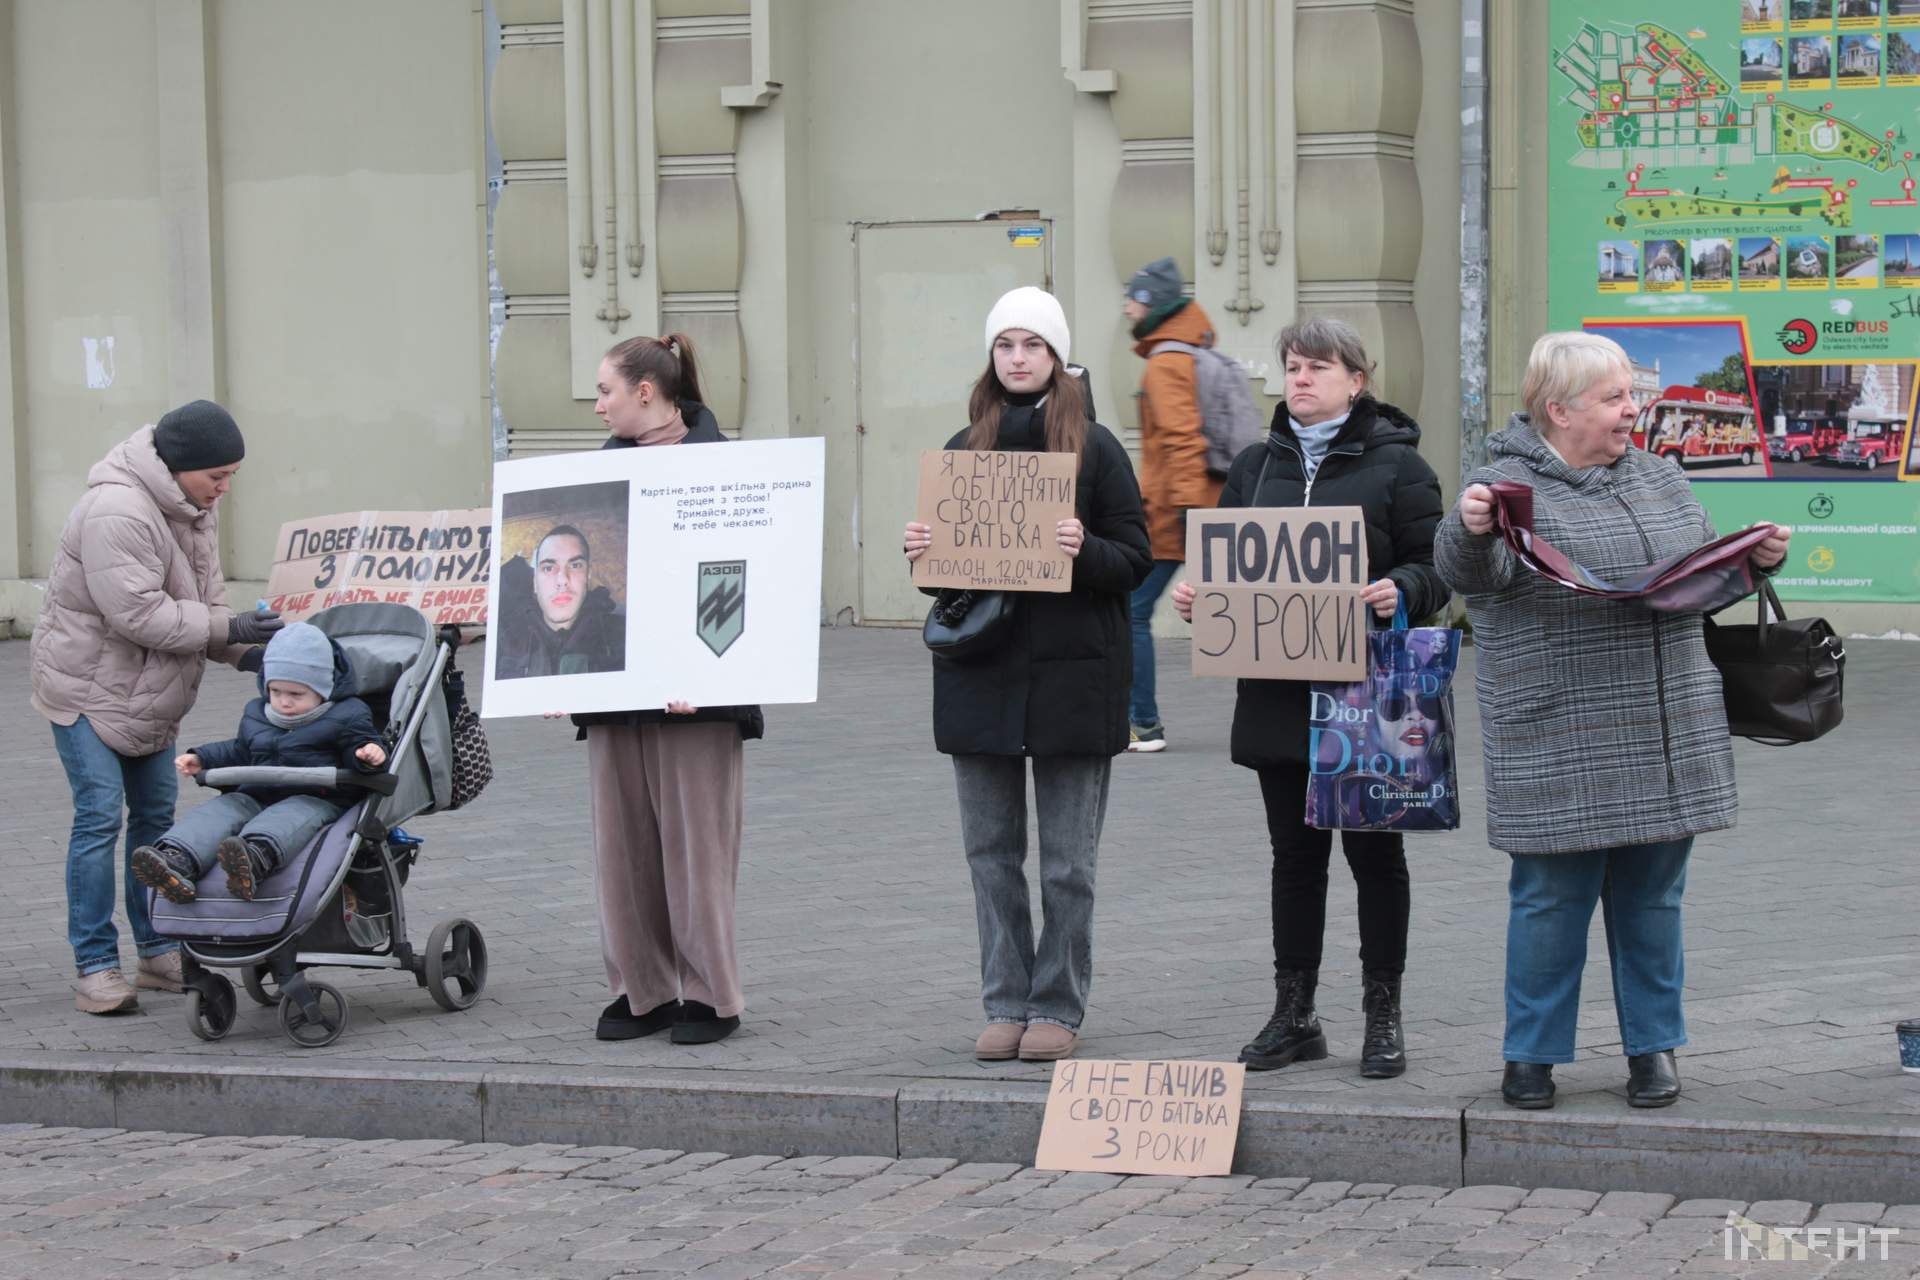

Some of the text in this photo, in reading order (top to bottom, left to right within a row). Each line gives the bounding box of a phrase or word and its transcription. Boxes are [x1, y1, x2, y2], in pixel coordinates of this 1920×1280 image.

[1644, 224, 1803, 237] PROVIDED BY THE BEST GUIDES
[1822, 320, 1889, 334] REDBUS
[938, 451, 1040, 479] Я МРІЮ
[720, 480, 767, 492] шкільна
[771, 479, 812, 491] родина
[951, 475, 1072, 504] ОБІЙНЯТИ
[676, 497, 715, 509] серцем
[732, 492, 772, 505] тобою!
[936, 498, 1026, 526] СВОГО
[672, 517, 774, 532] Ми тебе чекаємо!
[953, 522, 1042, 549] БАТЬКА
[1797, 523, 1878, 534] КРИМІНАЛЬНОЇ
[1880, 524, 1917, 534] ОДЕСИ
[477, 526, 491, 549] Т
[1200, 520, 1360, 584] ПОЛОН
[702, 565, 742, 577] АЗОВ
[927, 559, 986, 577] ПОЛОН
[1774, 577, 1873, 587] ЖОВТИЙ МАРШРУТ
[384, 591, 409, 603] НЕ
[420, 587, 486, 609] БАЧИВ
[1253, 592, 1357, 664] РОКИ
[1309, 690, 1374, 723] Dior
[1309, 726, 1410, 776] Dior
[1368, 783, 1428, 799] Christian
[1058, 1061, 1228, 1098] Я НЕ БАЧИВ
[1069, 1097, 1228, 1127] СВОГО БАТЬКА
[1135, 1130, 1207, 1163] РОКИ
